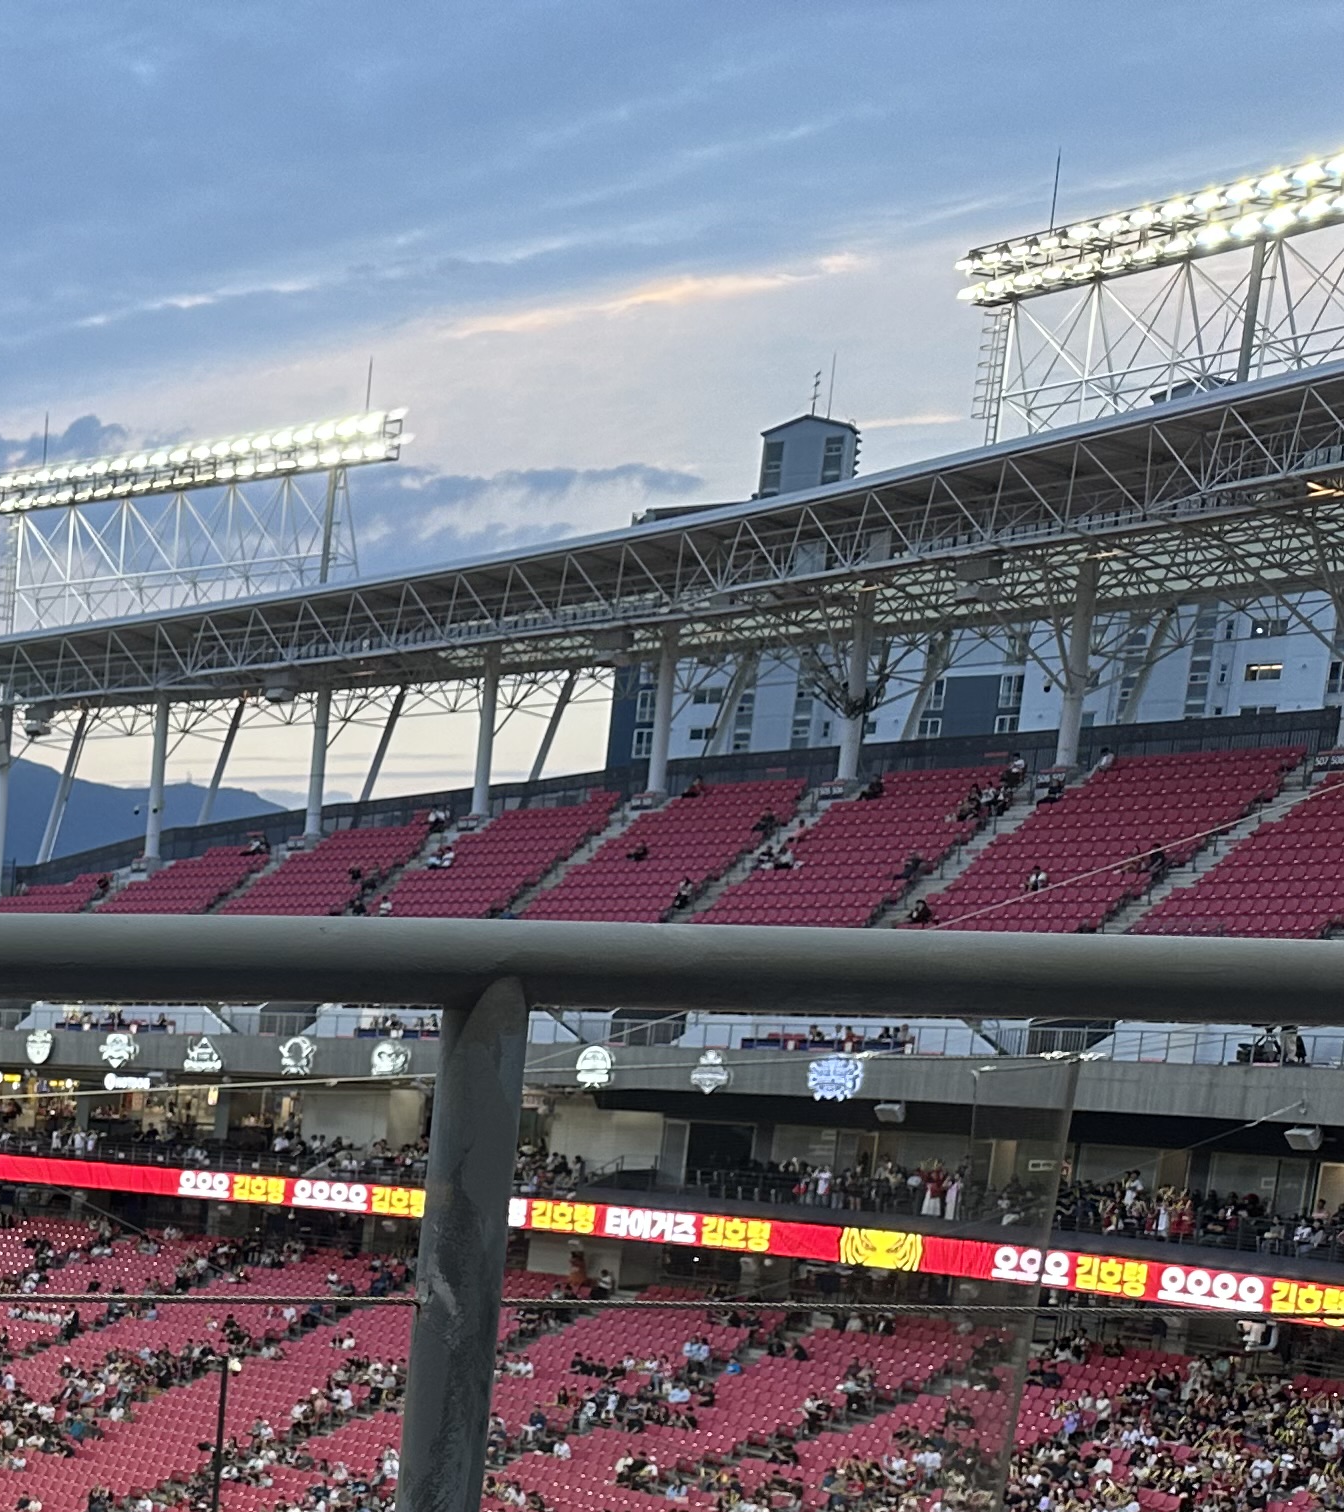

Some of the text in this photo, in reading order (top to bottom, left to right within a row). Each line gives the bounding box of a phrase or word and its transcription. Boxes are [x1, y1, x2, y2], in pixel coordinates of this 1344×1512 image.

[233, 1175, 286, 1204] 김호령
[371, 1186, 426, 1218] 김호령
[531, 1200, 596, 1234] 김호령
[605, 1207, 696, 1244] 타이거즈
[701, 1216, 772, 1252] 김호령
[1075, 1255, 1148, 1297] 김호령
